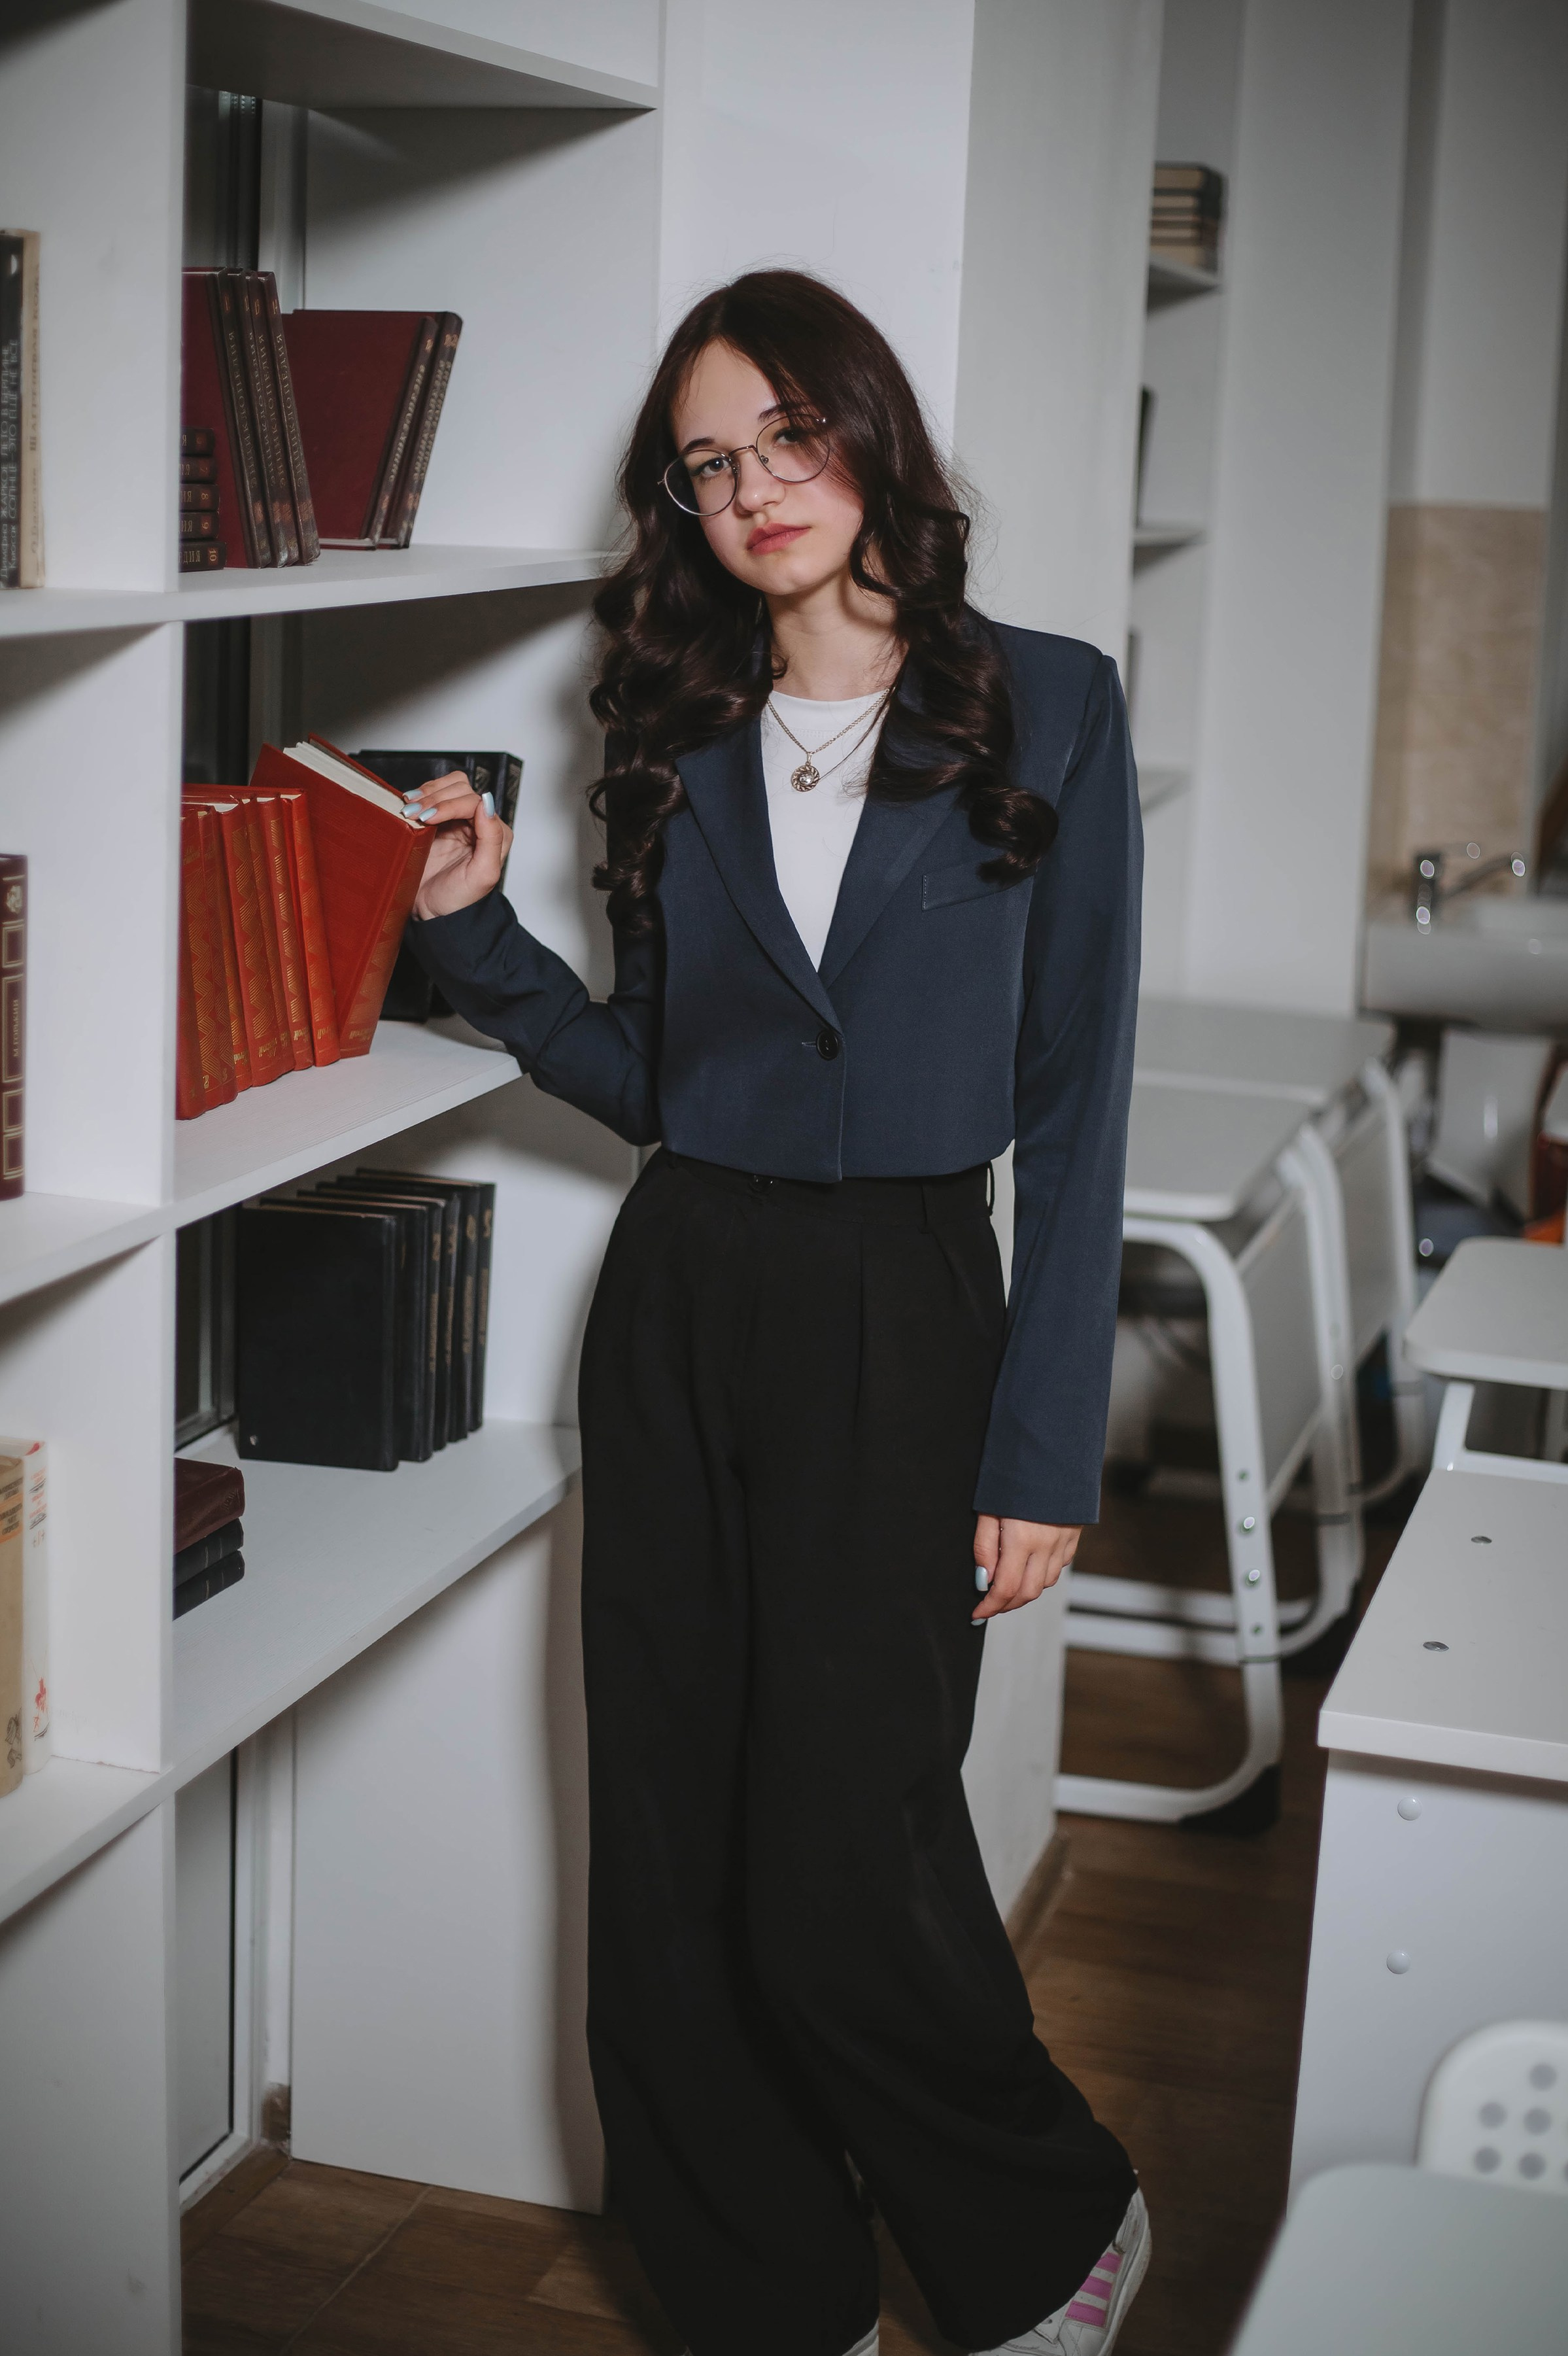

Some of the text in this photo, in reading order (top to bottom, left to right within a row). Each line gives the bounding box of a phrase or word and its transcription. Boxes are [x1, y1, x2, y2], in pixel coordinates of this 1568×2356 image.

[1, 345, 9, 404] БЕРЛИНЕ
[0, 421, 9, 457] ЛЕТО
[0, 463, 9, 519] ЖАРКОЕ
[0, 524, 9, 578] Димфна
[209, 549, 217, 562] 10
[203, 1075, 209, 1090] 2
